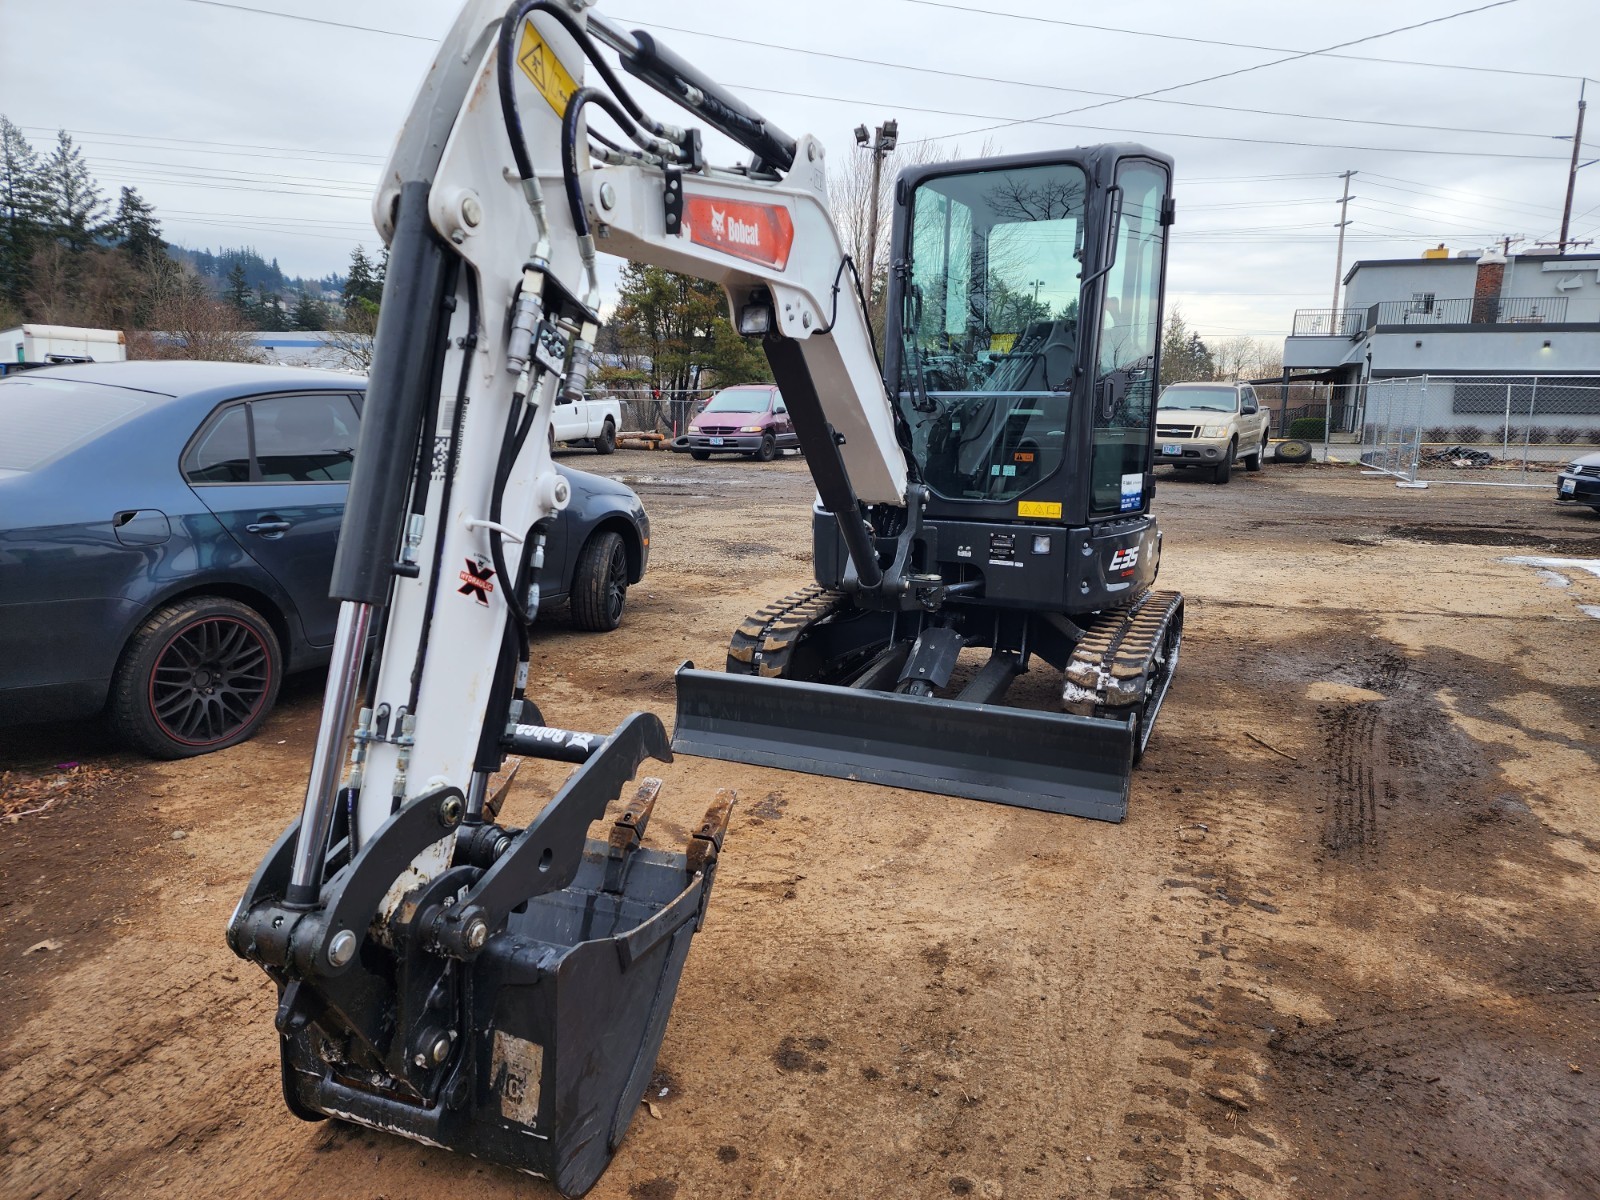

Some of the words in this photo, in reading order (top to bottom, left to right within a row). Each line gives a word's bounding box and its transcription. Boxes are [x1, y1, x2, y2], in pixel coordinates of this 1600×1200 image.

[727, 216, 760, 246] Bobcat
[1108, 545, 1140, 572] E35
[460, 572, 492, 591] HYDRAULIC
